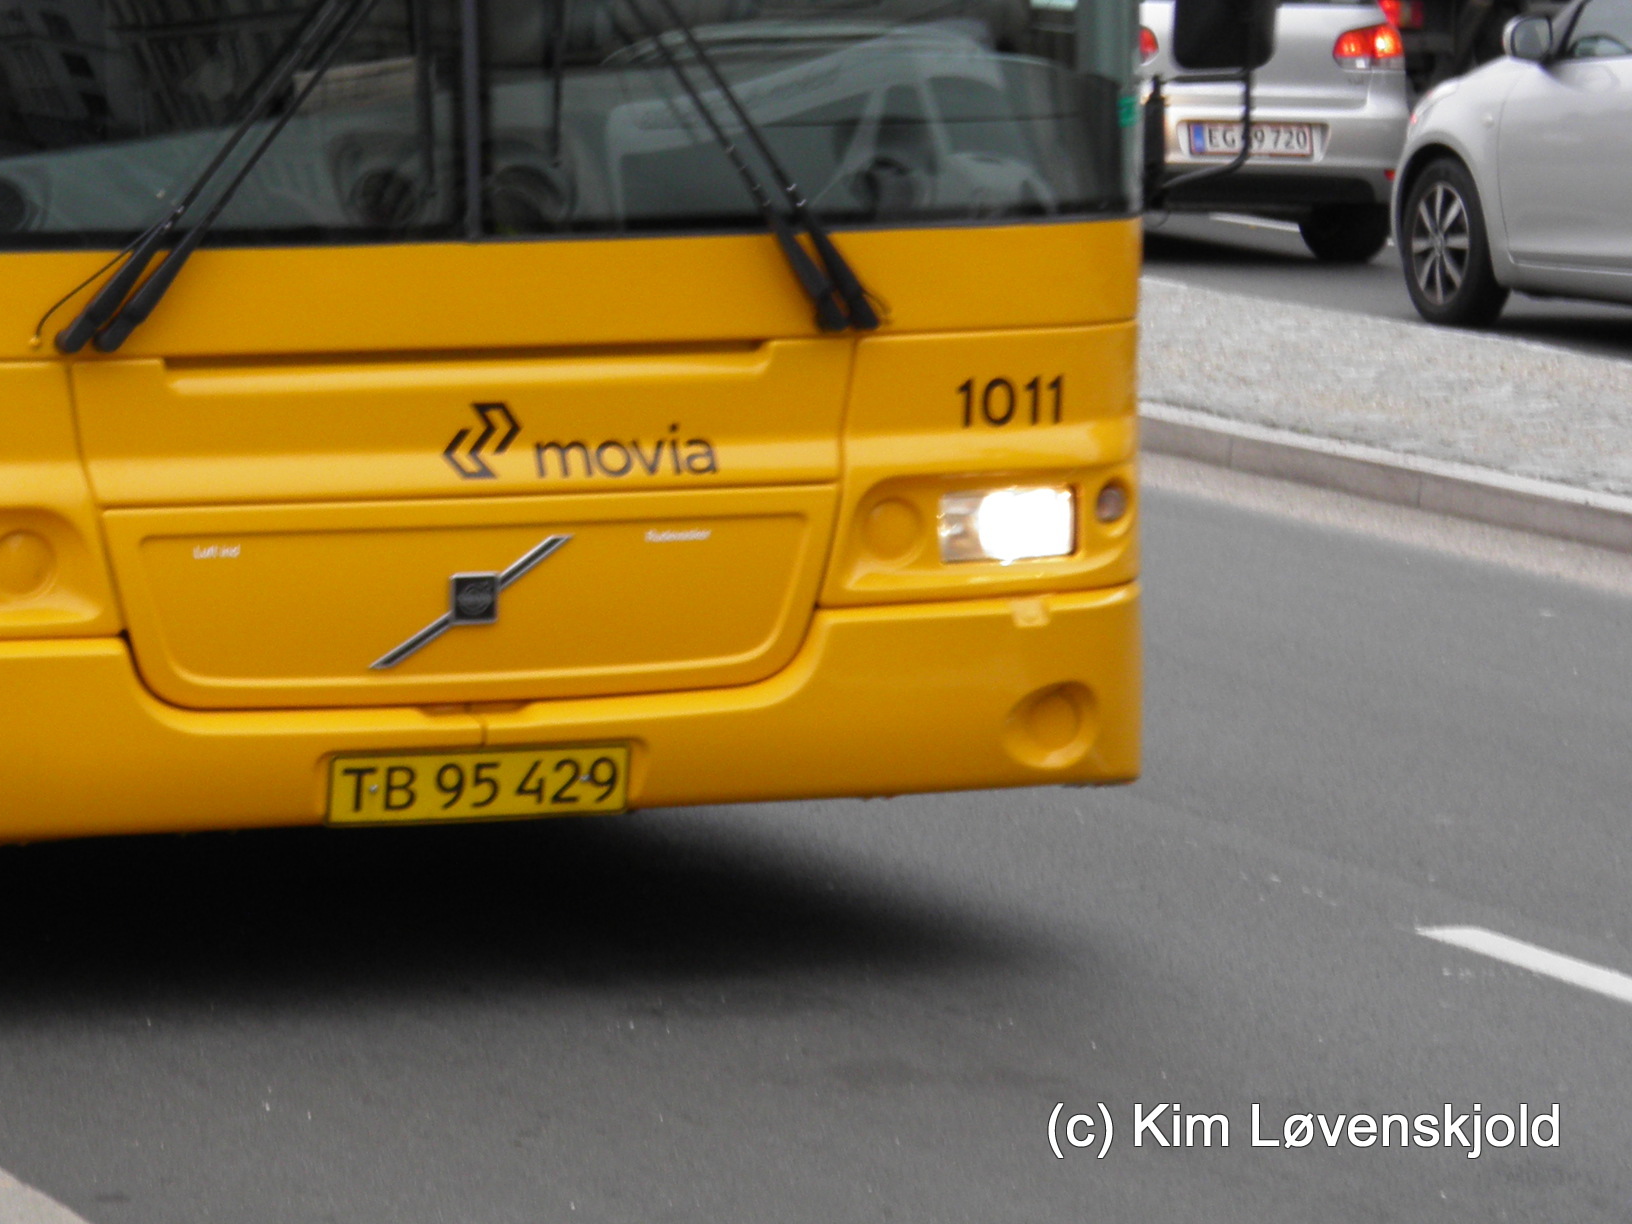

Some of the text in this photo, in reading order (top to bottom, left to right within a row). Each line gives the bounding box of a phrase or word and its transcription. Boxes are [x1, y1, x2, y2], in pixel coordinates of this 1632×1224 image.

[1208, 128, 1236, 148] EG
[1269, 128, 1308, 150] 720
[956, 375, 1065, 428] 1011
[535, 423, 718, 478] movia
[342, 756, 618, 812] TB 95 429
